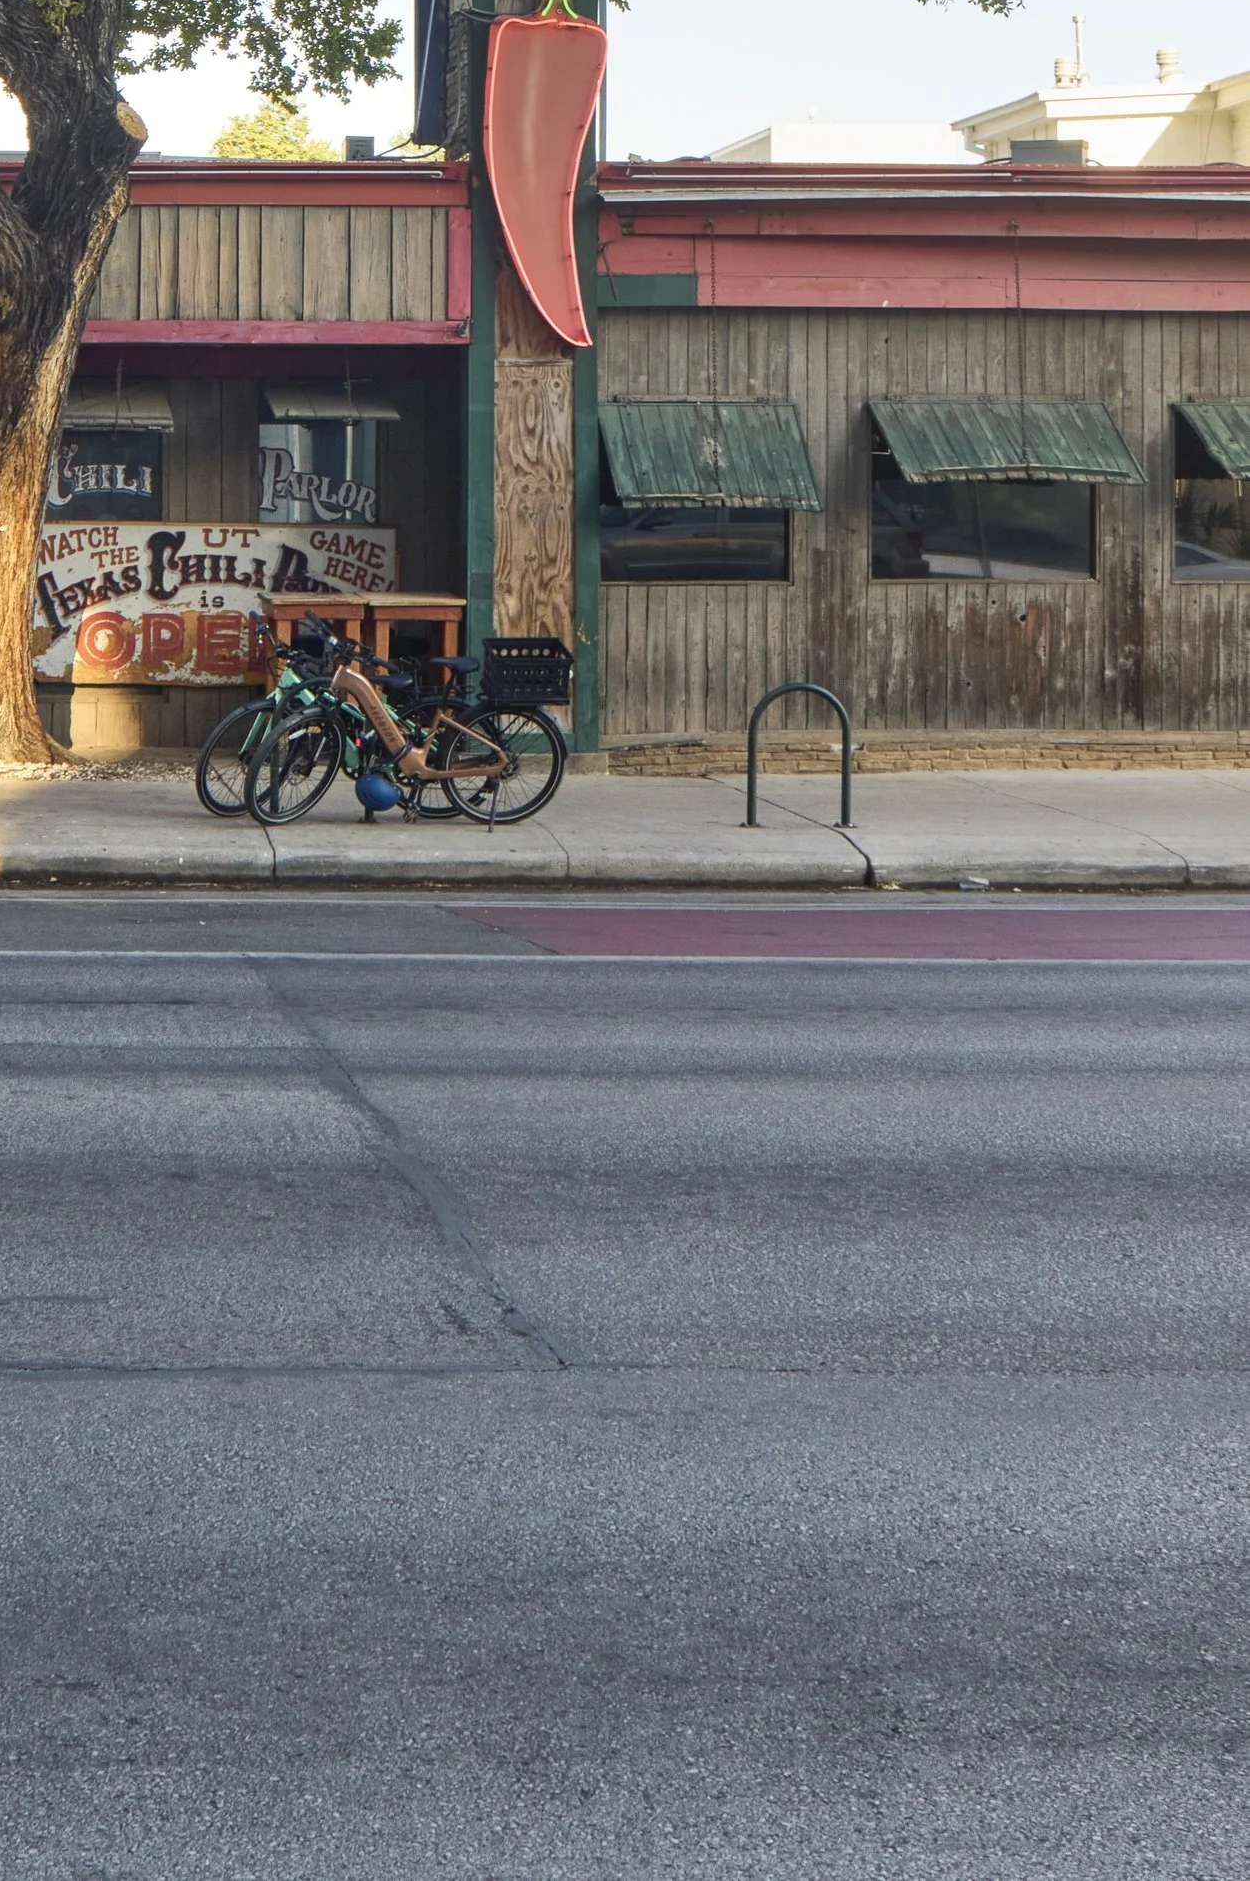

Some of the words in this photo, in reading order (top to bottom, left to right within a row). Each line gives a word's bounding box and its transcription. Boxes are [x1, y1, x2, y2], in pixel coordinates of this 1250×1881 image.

[47, 444, 153, 508] CHILI
[259, 447, 377, 523] PARLOR
[202, 528, 260, 548] UT
[310, 530, 386, 570] GAME
[90, 545, 140, 569] THE
[36, 564, 143, 640] TEXAS
[145, 530, 268, 600] CHILI
[199, 589, 225, 608] is
